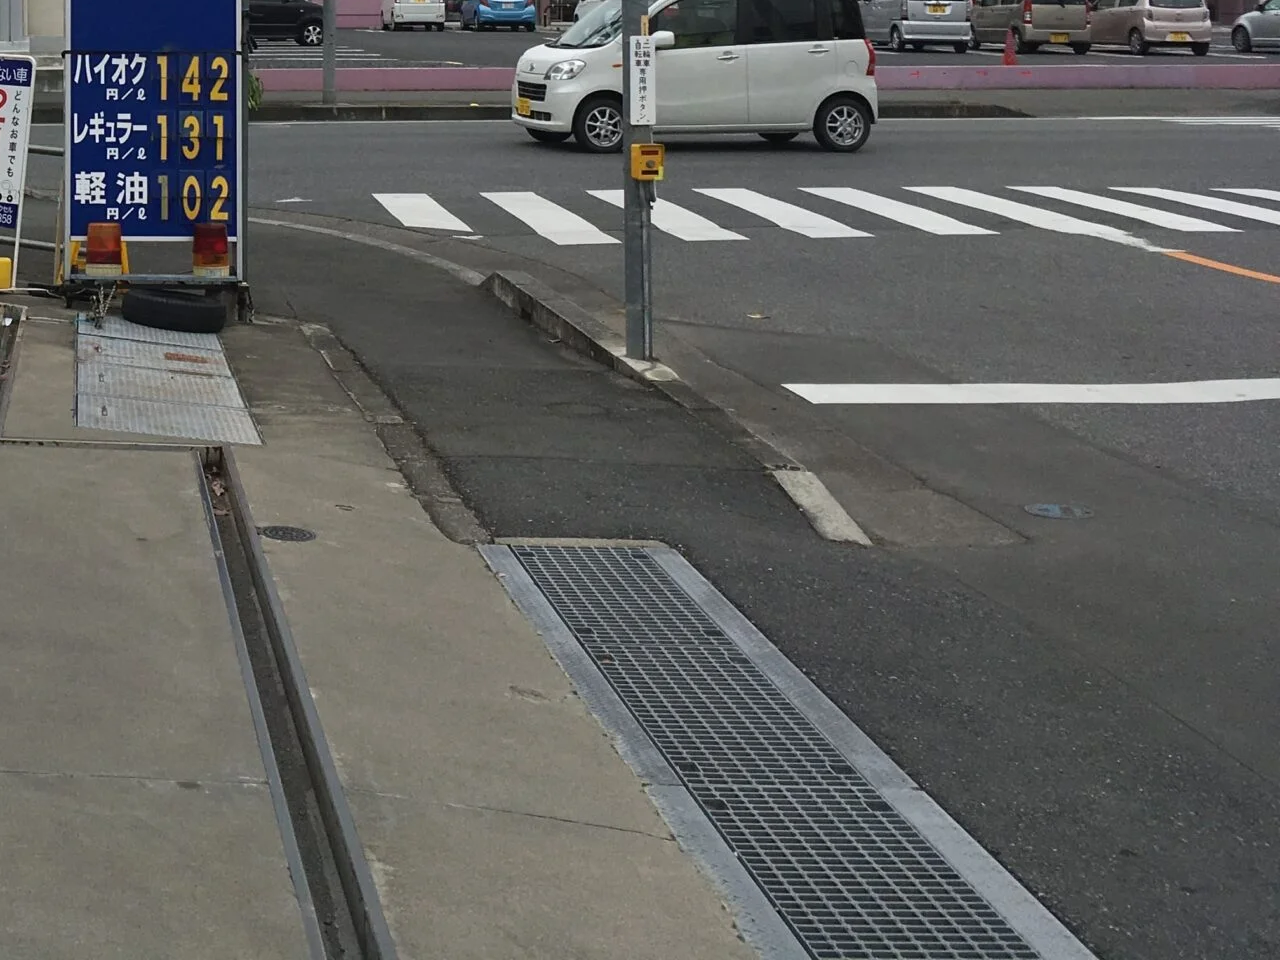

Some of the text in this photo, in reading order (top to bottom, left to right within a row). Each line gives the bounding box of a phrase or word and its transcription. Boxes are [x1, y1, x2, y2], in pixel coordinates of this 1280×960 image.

[74, 53, 229, 102] ハイオク 142
[6, 90, 23, 178] どんなお車でも
[73, 111, 225, 161] レギュラー 131
[157, 175, 229, 221] 102
